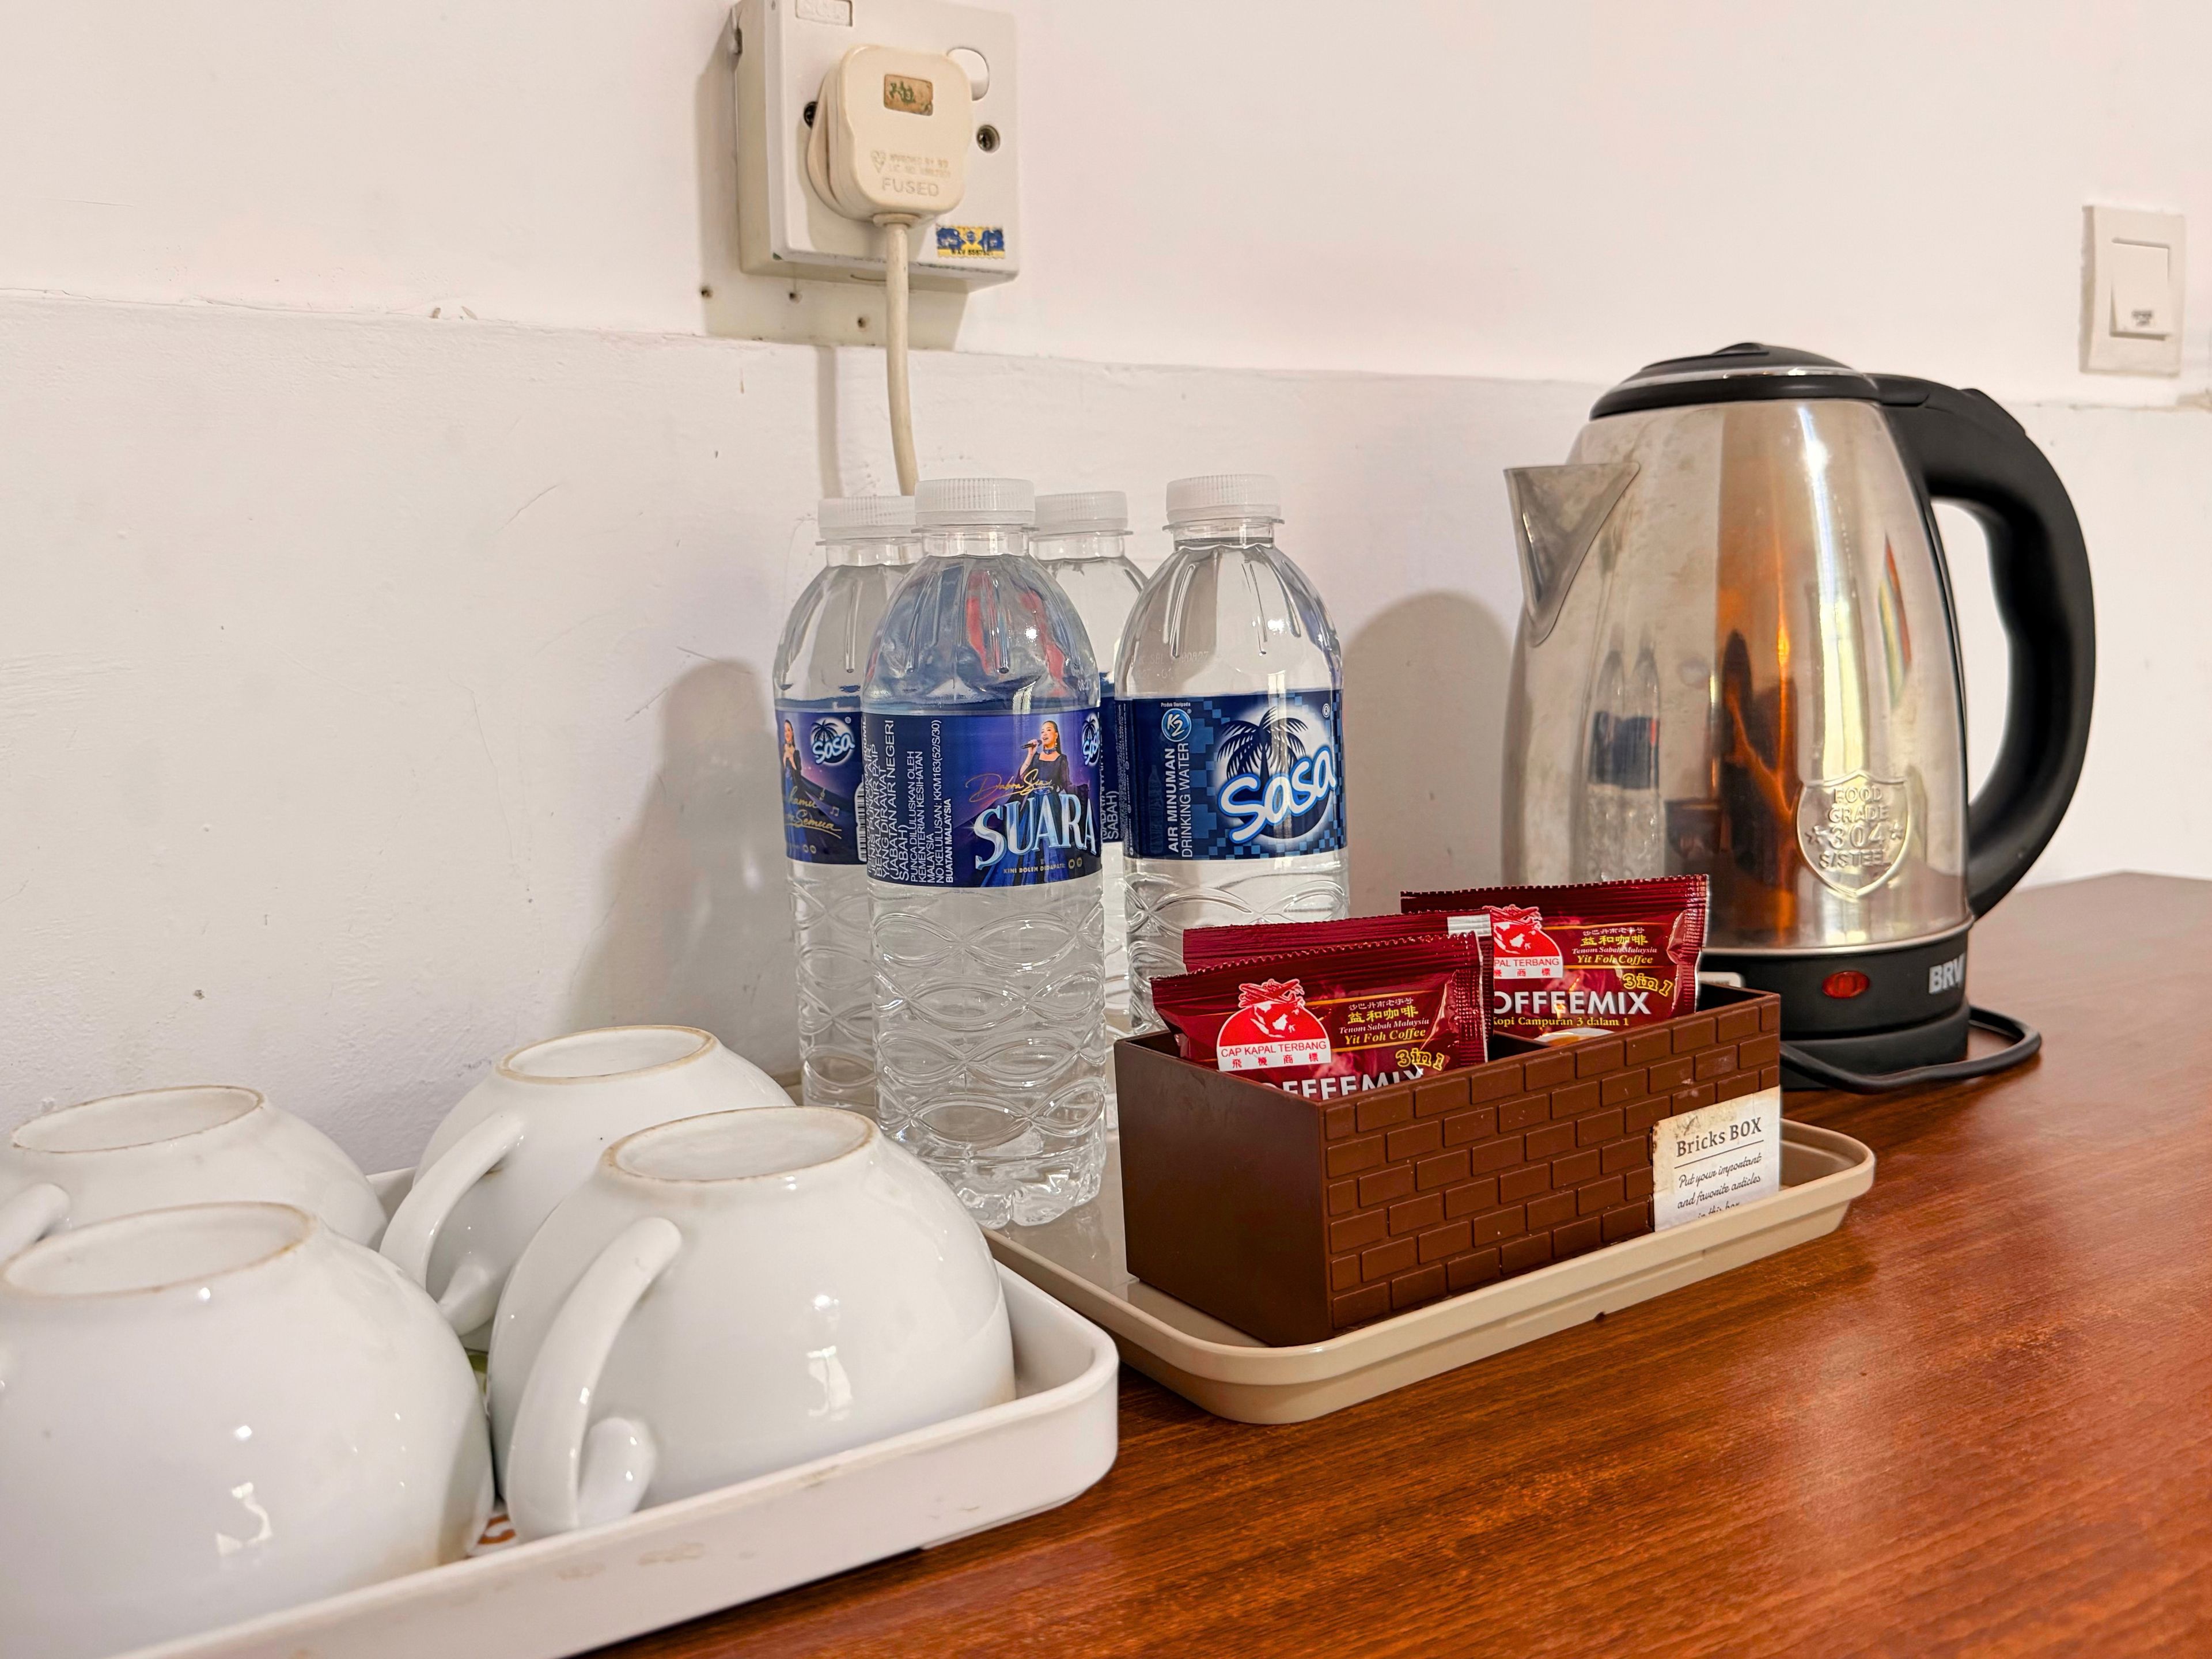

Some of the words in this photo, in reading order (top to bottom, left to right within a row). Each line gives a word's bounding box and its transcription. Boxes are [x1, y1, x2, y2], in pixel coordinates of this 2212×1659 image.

[882, 178, 940, 197] FUSED
[1167, 714, 1185, 737] K2
[871, 744, 879, 777] PAIP
[885, 720, 896, 778] NEGERI
[907, 751, 915, 779] OLEH
[931, 720, 943, 800] KKM163(52/S/30)
[915, 751, 925, 808] KESIHATAN
[1177, 743, 1190, 791] WATER
[878, 766, 888, 833] DIRAWAT
[887, 782, 897, 808] AIR
[1165, 748, 1177, 822] MINUMAN
[1218, 748, 1336, 842] Sasa
[1834, 786, 1883, 804] FOOD
[907, 782, 917, 845] DILULUSKAN
[944, 798, 952, 845] MALAYSIA
[1106, 790, 1119, 839] SABAH)
[1179, 794, 1193, 857] DRINKING
[1828, 805, 1889, 823] GRADE
[874, 808, 882, 877] BEKALAN
[888, 810, 900, 879] (JABATAN
[916, 810, 927, 882] KEMENTERIAN
[934, 802, 944, 866] KELULUSAN:
[974, 794, 1097, 870] SUARA
[1168, 827, 1179, 853] AIR
[1829, 822, 1885, 850] 304
[881, 837, 889, 877] YANG
[897, 824, 910, 881] SABAH)
[910, 847, 918, 882] PUNCA
[926, 833, 935, 883] MALAYSIA
[945, 846, 953, 883] BUATAN
[935, 868, 944, 884] NO
[1580, 934, 1648, 946] 益和咖啡
[1622, 946, 1657, 955] Malaysia
[1494, 959, 1511, 967] PAL
[1513, 958, 1559, 967] TERBANG
[1577, 955, 1592, 964] Yit
[1594, 955, 1615, 963] Foh
[1618, 955, 1653, 965] Coffee
[1347, 1005, 1419, 1024] 益和咖啡
[1494, 991, 1652, 1014] OFFEEMIX
[1339, 1026, 1366, 1034] Tenom
[1367, 1022, 1391, 1031] Sabah
[1393, 1018, 1429, 1028] Malaysia
[1345, 1035, 1360, 1044] Yit
[1363, 1032, 1386, 1043] Foh
[1389, 1028, 1426, 1040] Coffee
[1518, 1017, 1573, 1028] Campuran
[1577, 1017, 1584, 1026] 3
[1587, 1017, 1619, 1026] dalam
[1221, 1048, 1241, 1057] CAP
[1244, 1045, 1276, 1055] KAPAL
[1278, 1041, 1327, 1052] TERBANG
[1232, 1052, 1319, 1068] 飛機商標
[1676, 1131, 1725, 1158] Bricks
[1730, 1117, 1762, 1141] BOX
[1679, 1173, 1695, 1188] Put
[1695, 1170, 1717, 1187] your
[1718, 1153, 1762, 1177] important
[1677, 1192, 1696, 1209] and
[1695, 1183, 1730, 1205] favorite
[1731, 1173, 1761, 1191] articles
